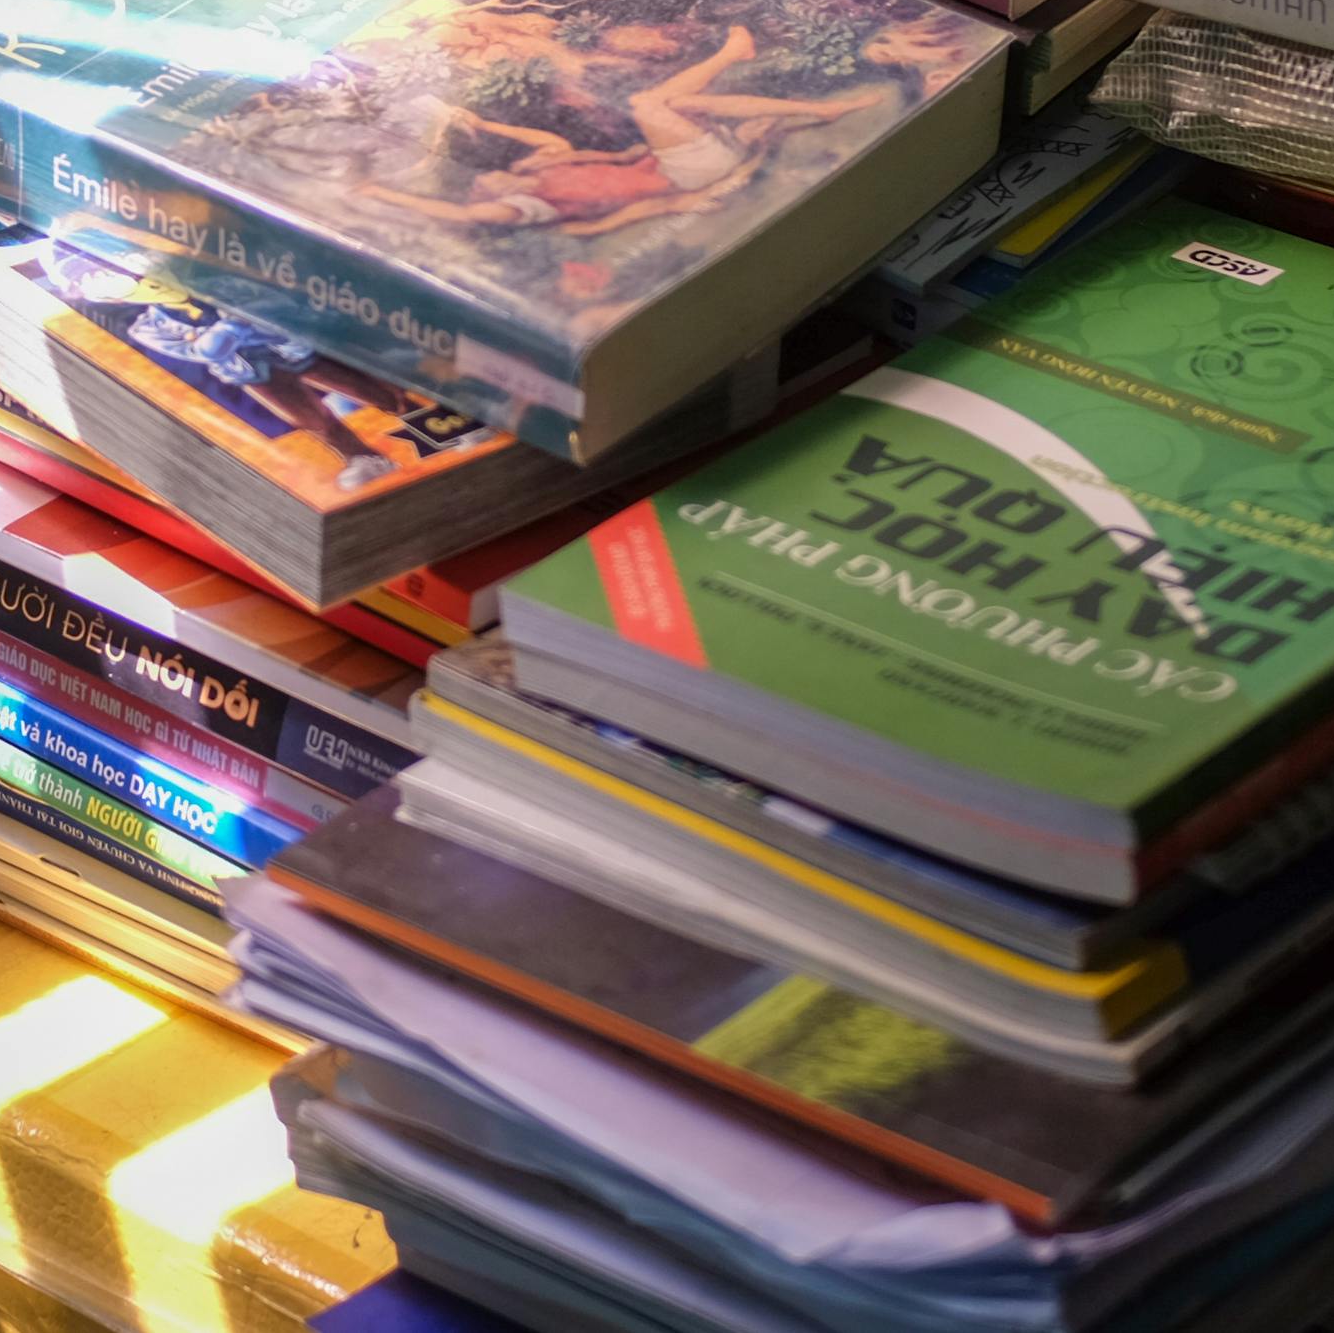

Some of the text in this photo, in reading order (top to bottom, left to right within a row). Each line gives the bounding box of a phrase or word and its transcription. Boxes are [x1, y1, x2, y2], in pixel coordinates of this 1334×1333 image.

[148, 195, 208, 261] hay
[218, 226, 247, 268] là
[306, 269, 380, 326] giáo
[1188, 247, 1268, 278] ASCD
[677, 498, 841, 567] PHÁP
[831, 431, 1067, 535] QUẢ
[808, 487, 1048, 592] HỌC
[834, 552, 1099, 666] PHƯƠNG
[1033, 577, 1292, 666] DẠY
[30, 657, 57, 687] DỤC
[58, 670, 88, 702] VIỆT
[90, 685, 122, 716] NAM
[125, 705, 153, 734] HỌC
[191, 739, 229, 773] NHẬT
[62, 610, 128, 664] ĐỀU
[136, 644, 196, 698] NÓI
[199, 679, 259, 728] DỐI
[1093, 648, 1237, 703] CÁC
[19, 717, 41, 743] và
[45, 725, 89, 768] khoa
[92, 753, 125, 789] học
[130, 773, 172, 810] DẠY
[173, 797, 217, 834] HỌC
[38, 770, 84, 810] thành
[85, 795, 143, 841] NGƯỜI
